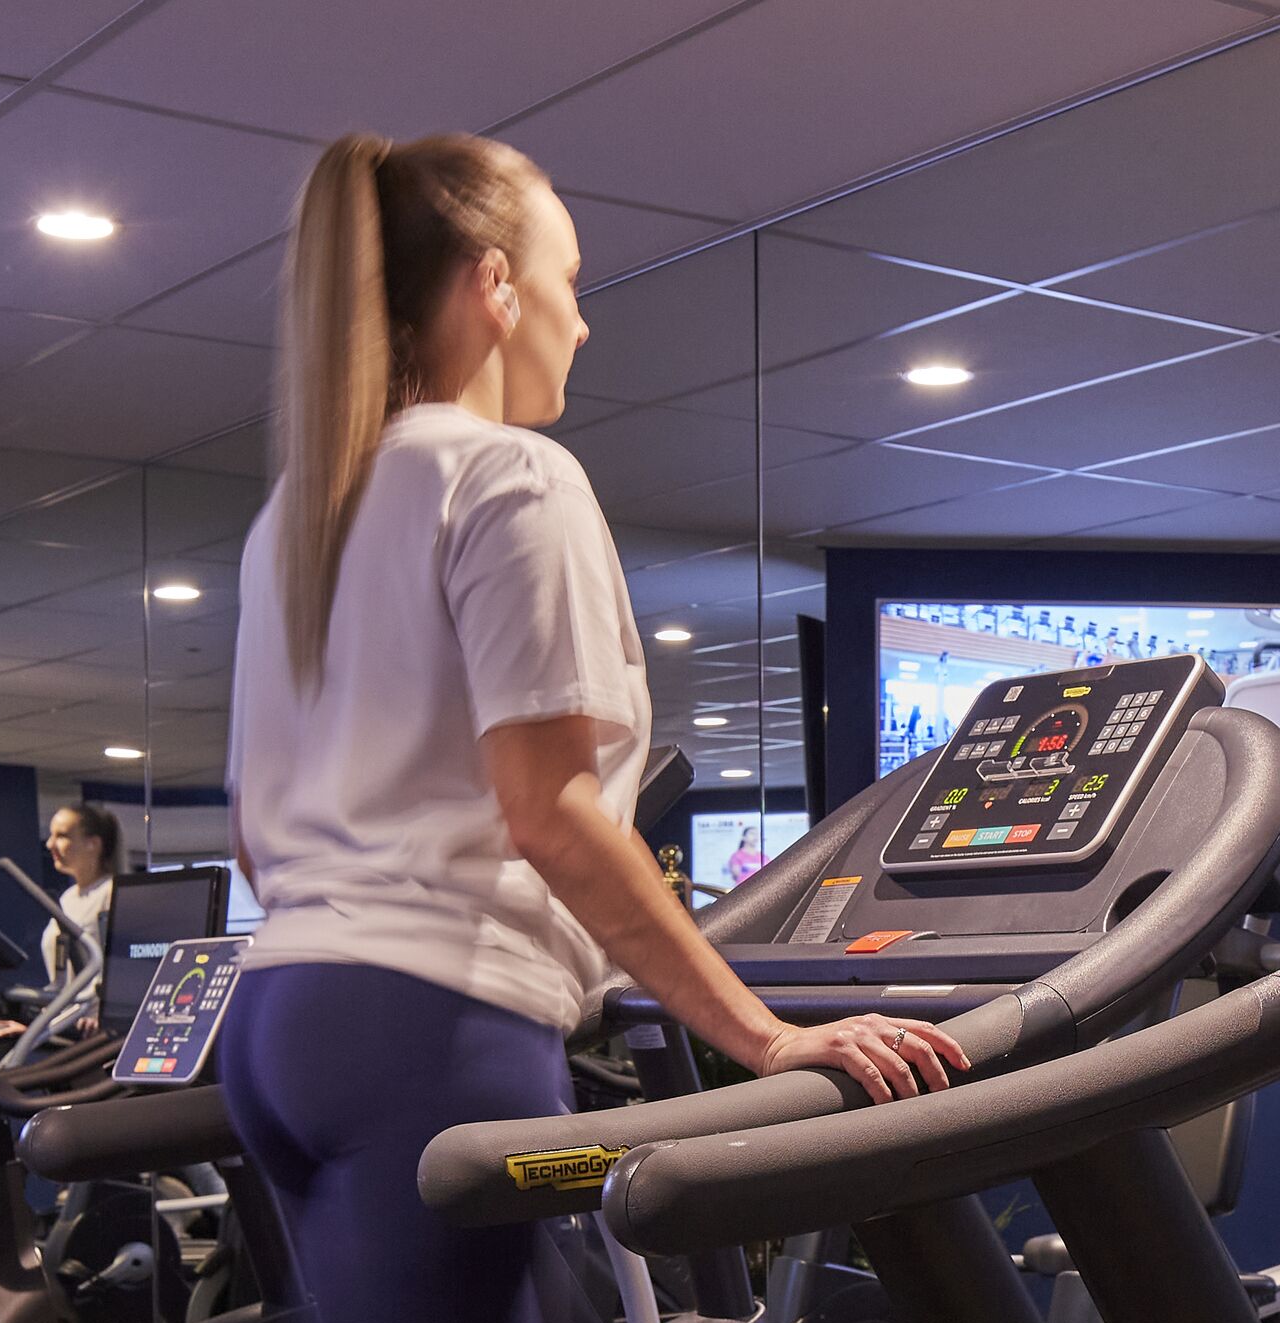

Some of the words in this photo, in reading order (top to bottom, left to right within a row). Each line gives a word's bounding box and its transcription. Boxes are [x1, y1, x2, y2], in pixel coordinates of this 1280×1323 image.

[1135, 695, 1143, 704] 2
[1149, 693, 1158, 702] 3
[1112, 712, 1120, 720] 4
[1126, 711, 1134, 719] 5
[1141, 709, 1148, 717] 6
[1117, 726, 1125, 735] 8
[1132, 725, 1140, 733] 9
[1107, 742, 1116, 750] 0
[1043, 779, 1060, 796] 3
[977, 830, 1004, 840] START
[1012, 829, 1033, 838] STOP
